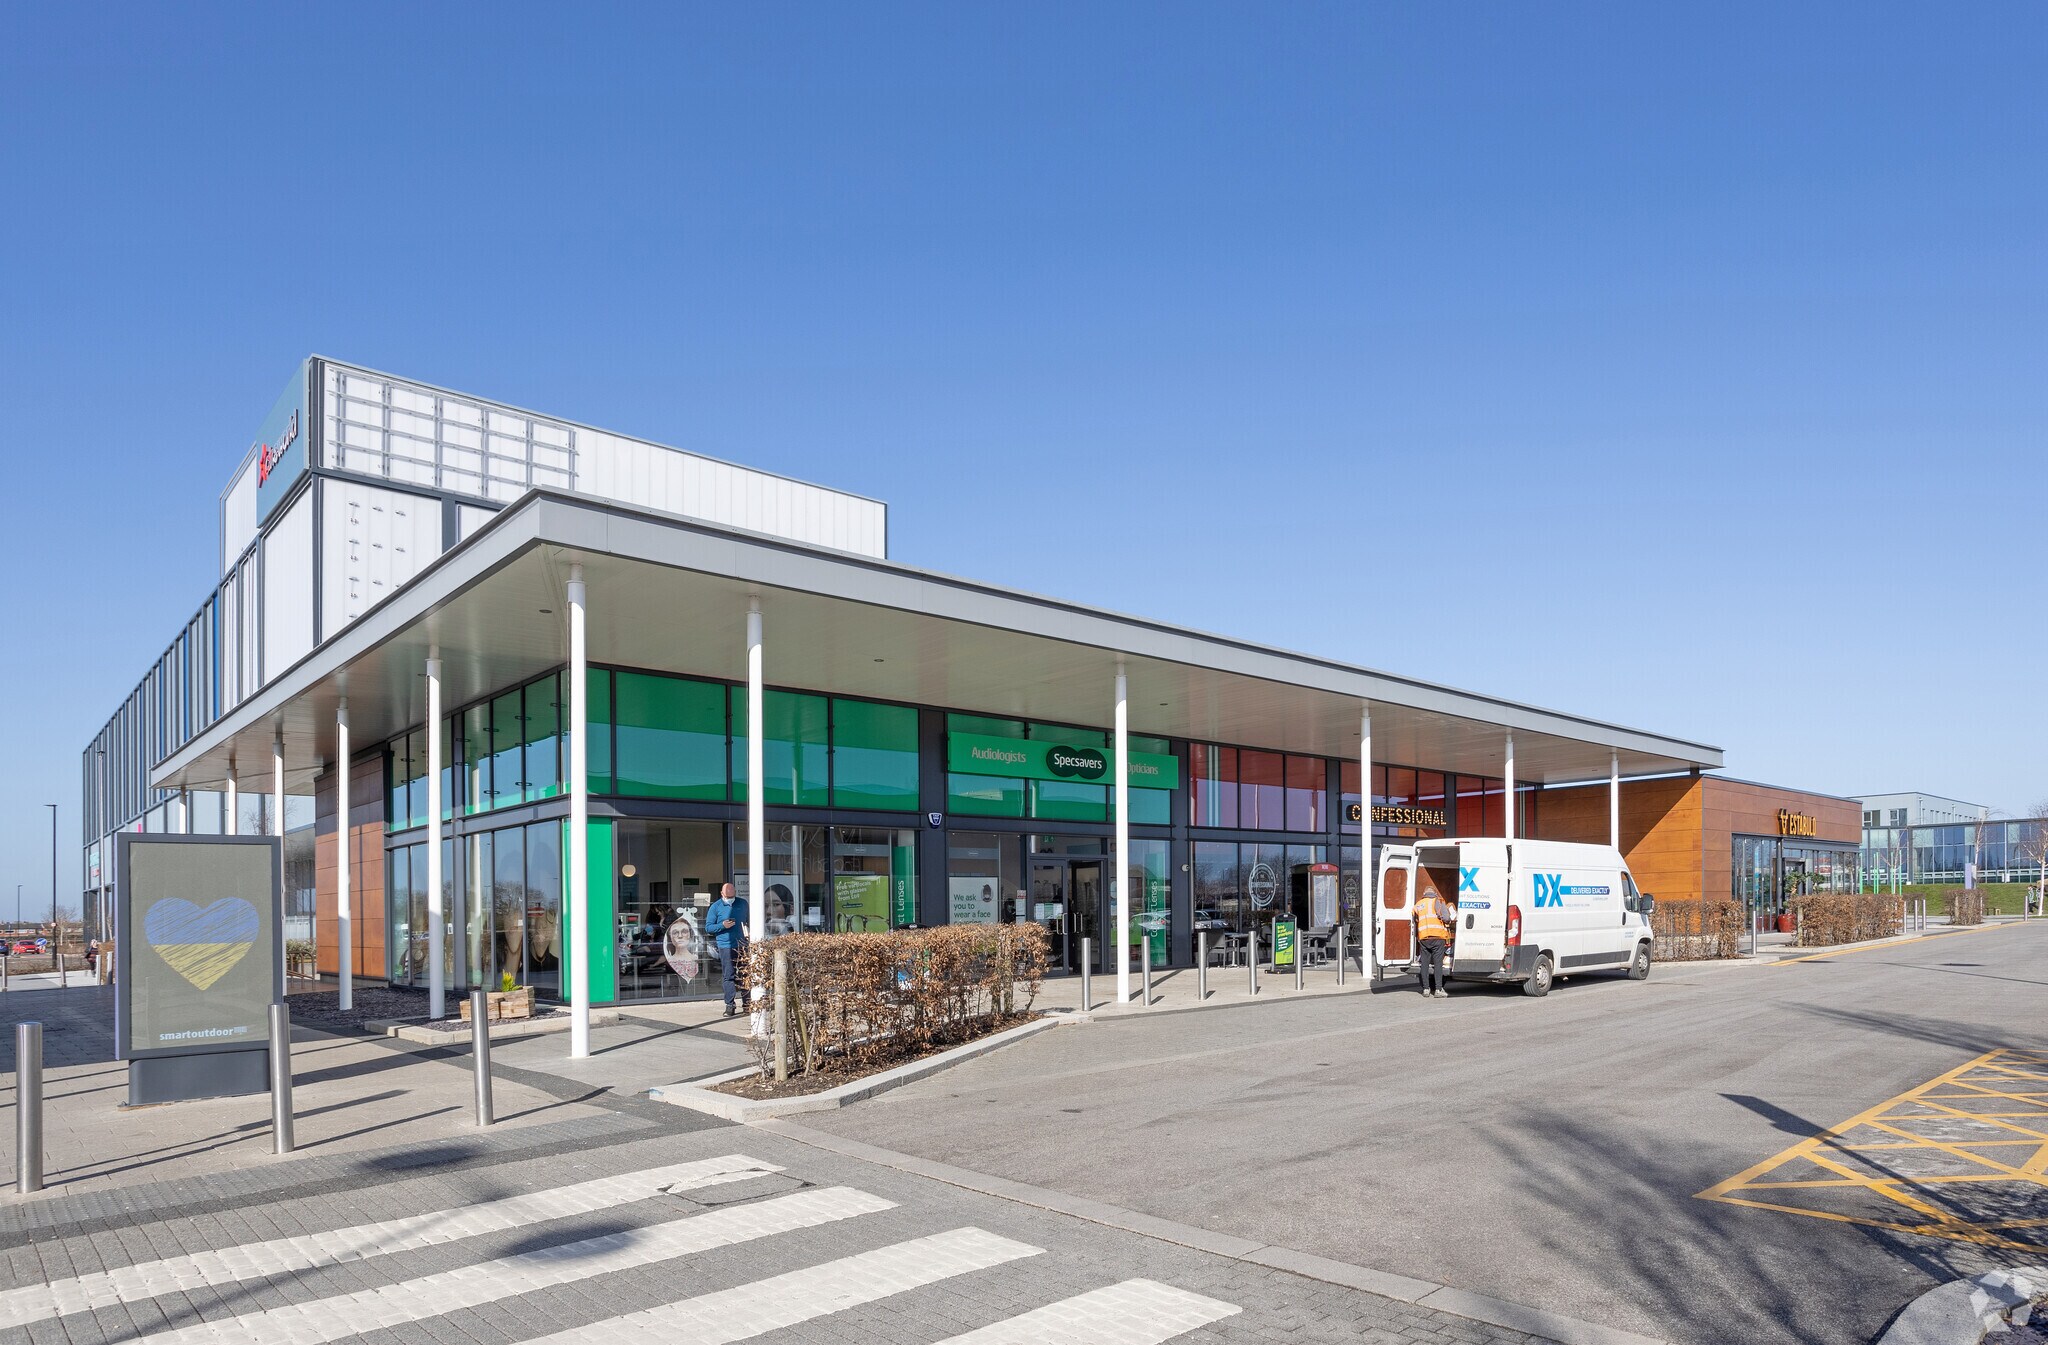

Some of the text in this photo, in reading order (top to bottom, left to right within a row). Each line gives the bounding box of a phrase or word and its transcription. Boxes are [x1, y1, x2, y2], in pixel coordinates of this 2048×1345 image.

[971, 747, 1027, 763] Audiologists
[1054, 753, 1103, 769] Specsavers
[1352, 804, 1446, 825] CNFESSIONAL
[1533, 873, 1563, 907] DX
[953, 903, 967, 911] you
[977, 910, 991, 918] face
[160, 1028, 234, 1040] smartoutdoor
